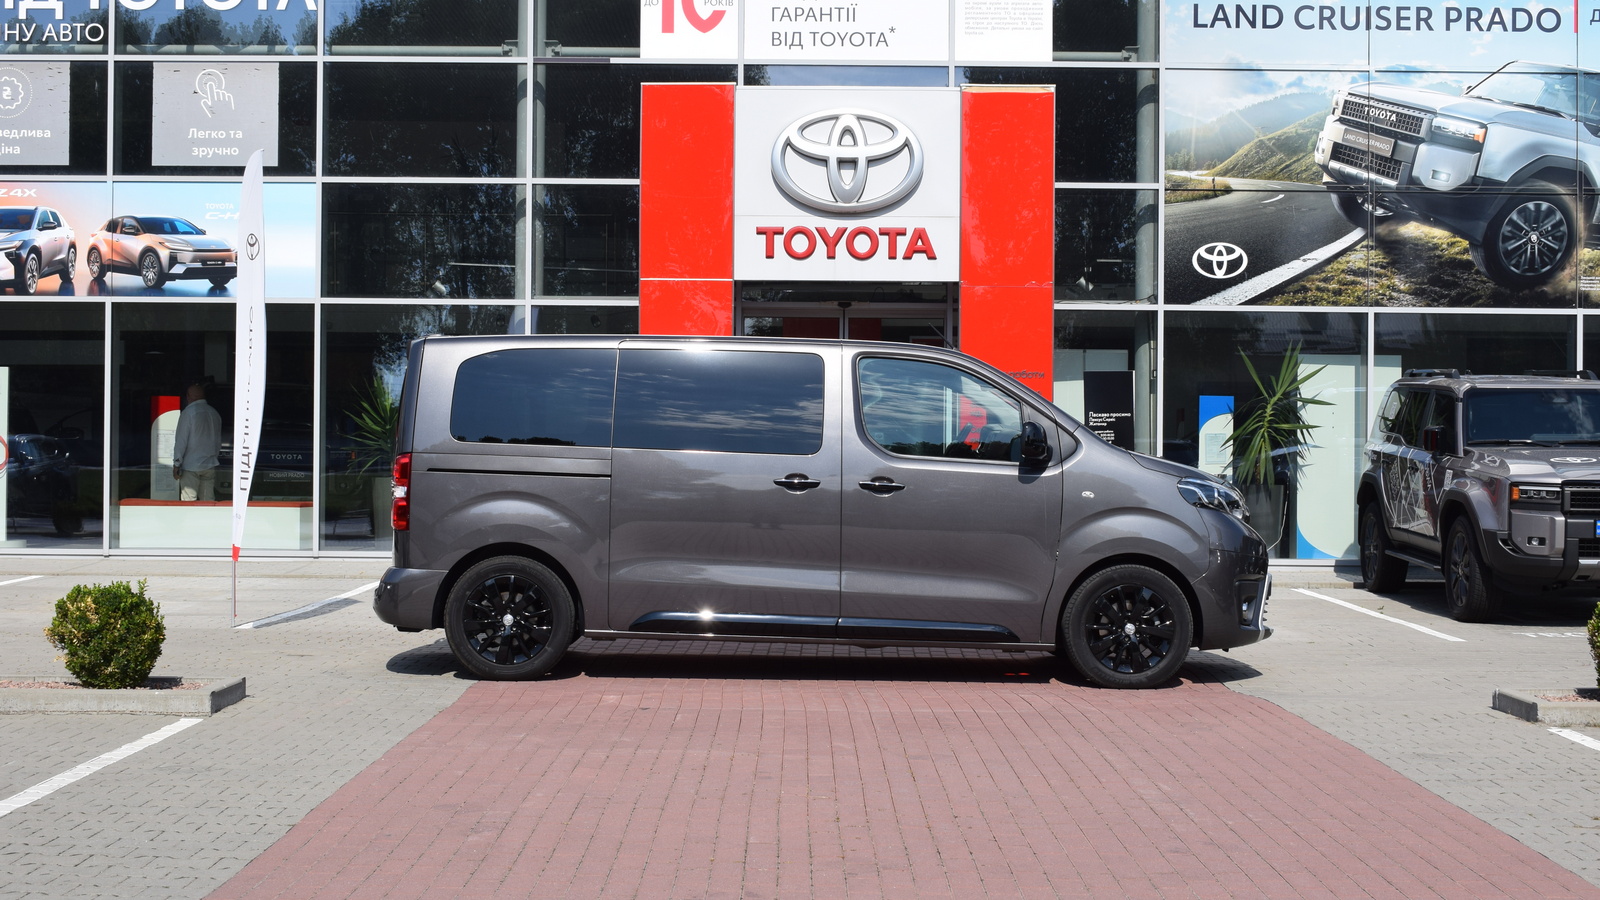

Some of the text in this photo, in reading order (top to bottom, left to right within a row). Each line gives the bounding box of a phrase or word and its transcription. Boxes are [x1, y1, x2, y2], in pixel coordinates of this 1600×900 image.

[771, 3, 858, 22] ГАРАНТІЇ
[1193, 3, 1562, 33] LAND CRUISER PRADO
[0, 23, 104, 41] НУ АВТО
[771, 31, 804, 50] ВІД
[1364, 107, 1396, 122] TOYOTA
[188, 128, 243, 139] Легко та
[0, 144, 20, 154] іна
[192, 147, 239, 158] зручно
[756, 226, 937, 260] TOYOTA
